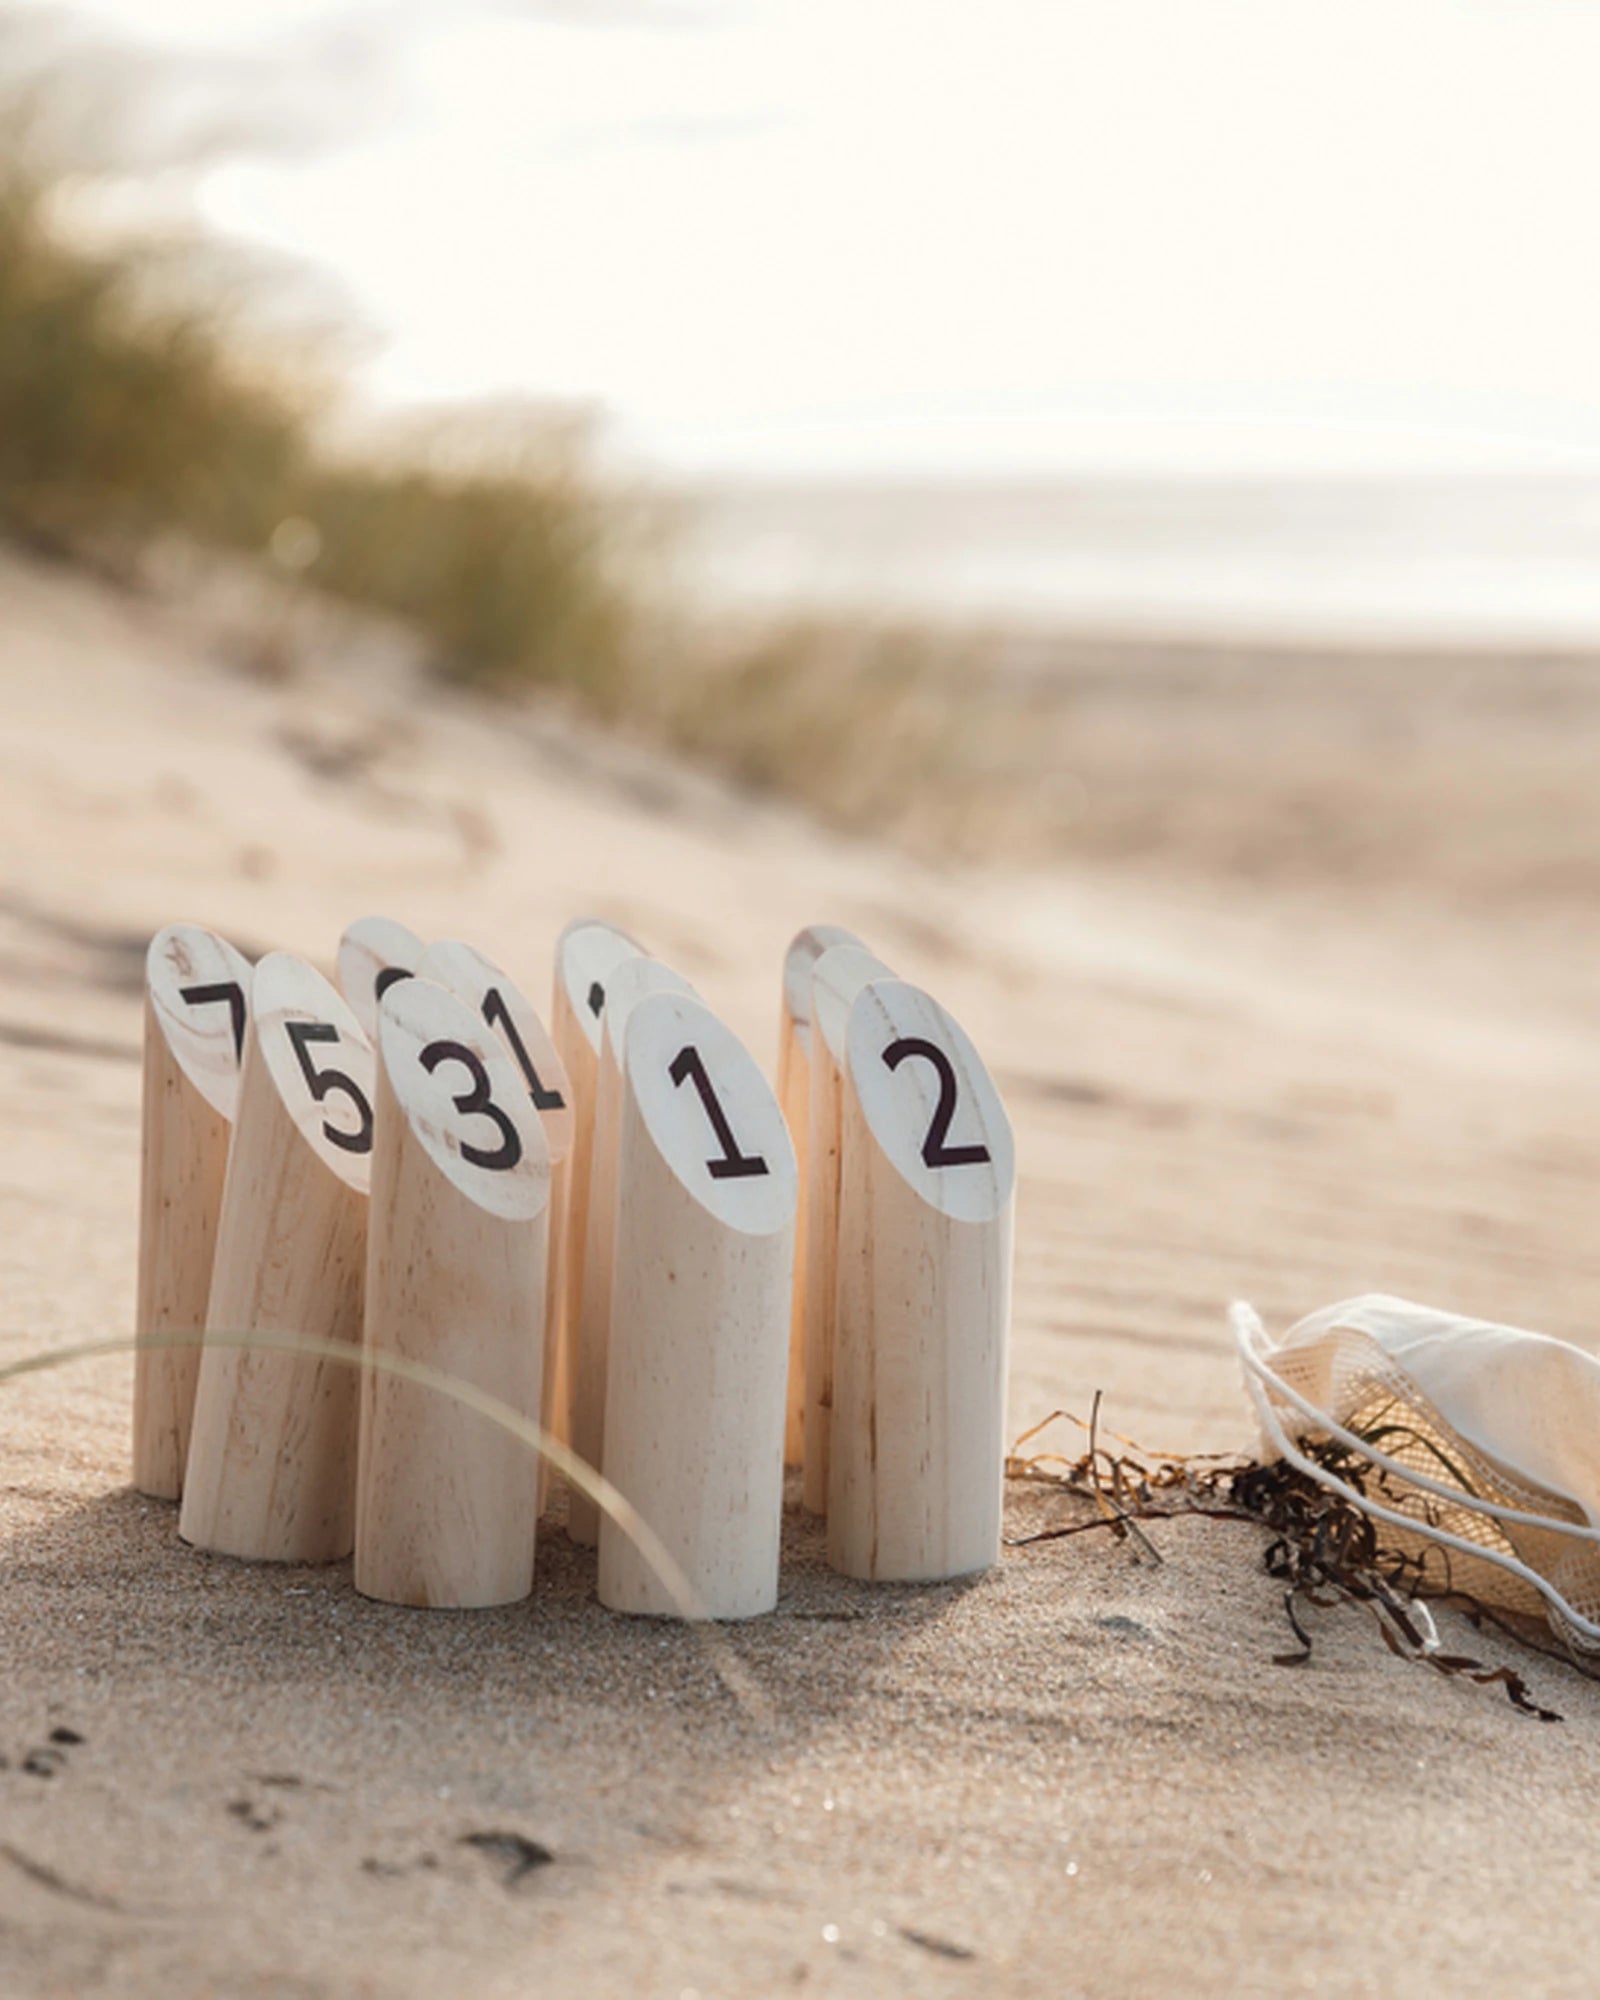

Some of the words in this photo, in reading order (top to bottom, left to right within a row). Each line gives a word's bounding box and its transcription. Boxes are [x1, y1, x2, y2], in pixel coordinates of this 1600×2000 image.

[179, 982, 245, 1067] 7
[285, 1022, 373, 1154] 5
[419, 1040, 522, 1170] 3
[669, 1046, 769, 1179] 1
[882, 1037, 991, 1168] 2
